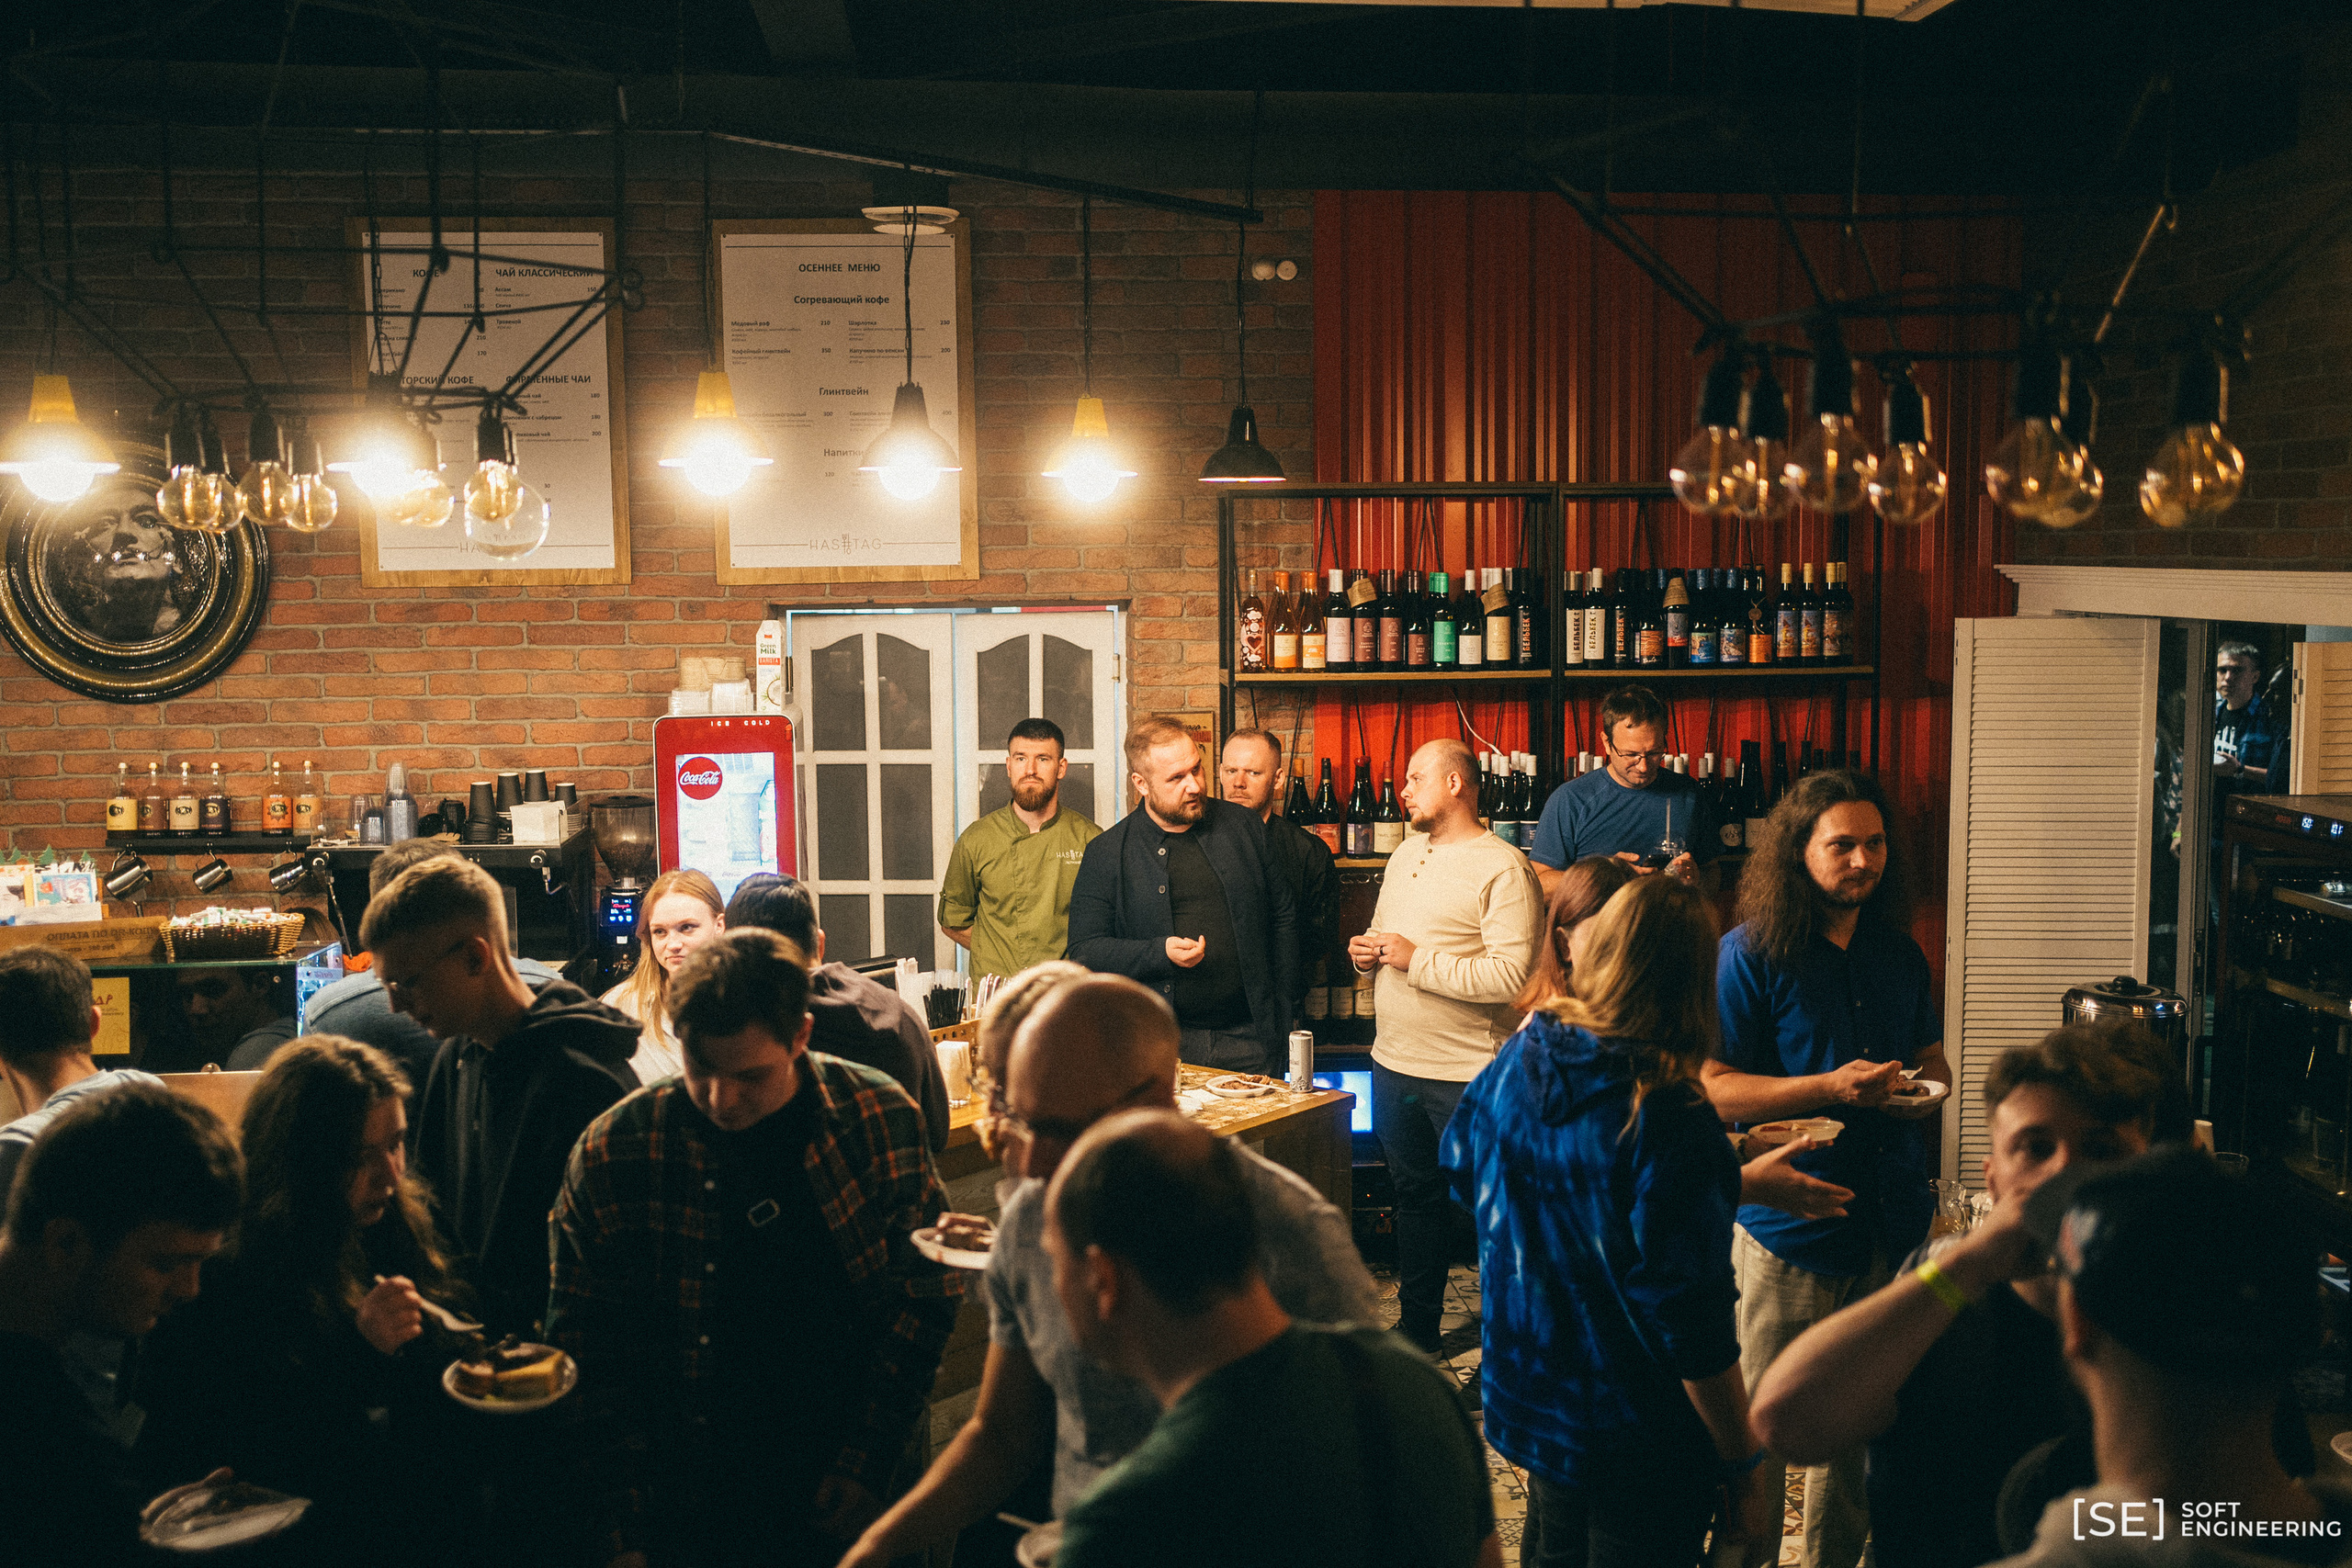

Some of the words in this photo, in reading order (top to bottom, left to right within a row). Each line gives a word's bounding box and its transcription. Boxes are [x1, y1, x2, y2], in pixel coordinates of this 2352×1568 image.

[495, 267, 515, 277] ЧАЙ
[798, 264, 842, 272] ОСЕННЕЕ
[847, 263, 880, 272] МЕНЮ
[794, 295, 863, 305] Согревающий
[865, 295, 889, 305] кофе
[447, 375, 475, 385] КОФЕ
[571, 375, 592, 384] ЧАИ
[819, 386, 869, 396] Глинтвейн
[823, 447, 865, 457] Напитки
[1573, 617, 1581, 651] БЕЛЬБЕК
[679, 769, 722, 787] Coca-Cola
[46, 931, 89, 942] ОПЛАТА
[92, 930, 108, 938] ПО
